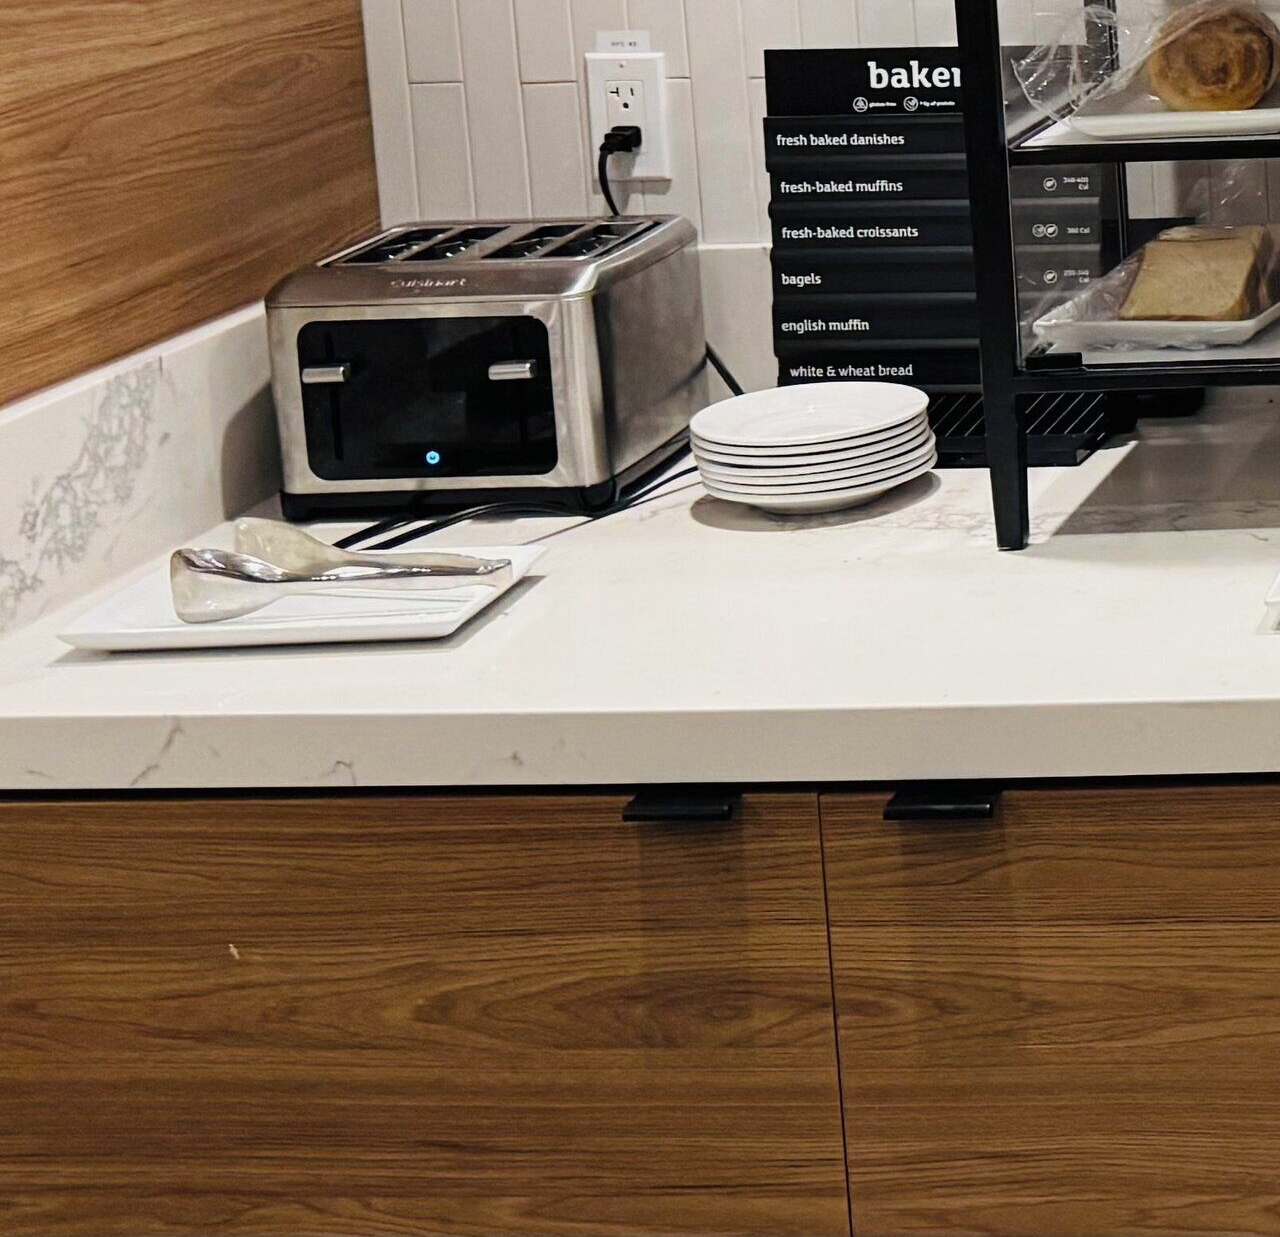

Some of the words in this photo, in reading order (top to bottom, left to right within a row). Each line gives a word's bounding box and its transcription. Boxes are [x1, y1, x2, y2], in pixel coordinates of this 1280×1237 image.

[867, 61, 961, 88] baker
[776, 134, 808, 146] fresh
[809, 133, 848, 146] baked
[849, 133, 905, 146] danishes
[780, 180, 854, 194] fresh-baked
[855, 179, 904, 192] muffins
[781, 226, 855, 239] fresh-baked
[856, 226, 919, 238] croissants
[781, 272, 822, 288] bagels
[781, 319, 826, 334] english
[828, 318, 870, 331] muffin
[789, 365, 824, 377] white
[826, 365, 837, 377] &
[837, 364, 876, 377] wheat
[878, 363, 913, 376] bread
